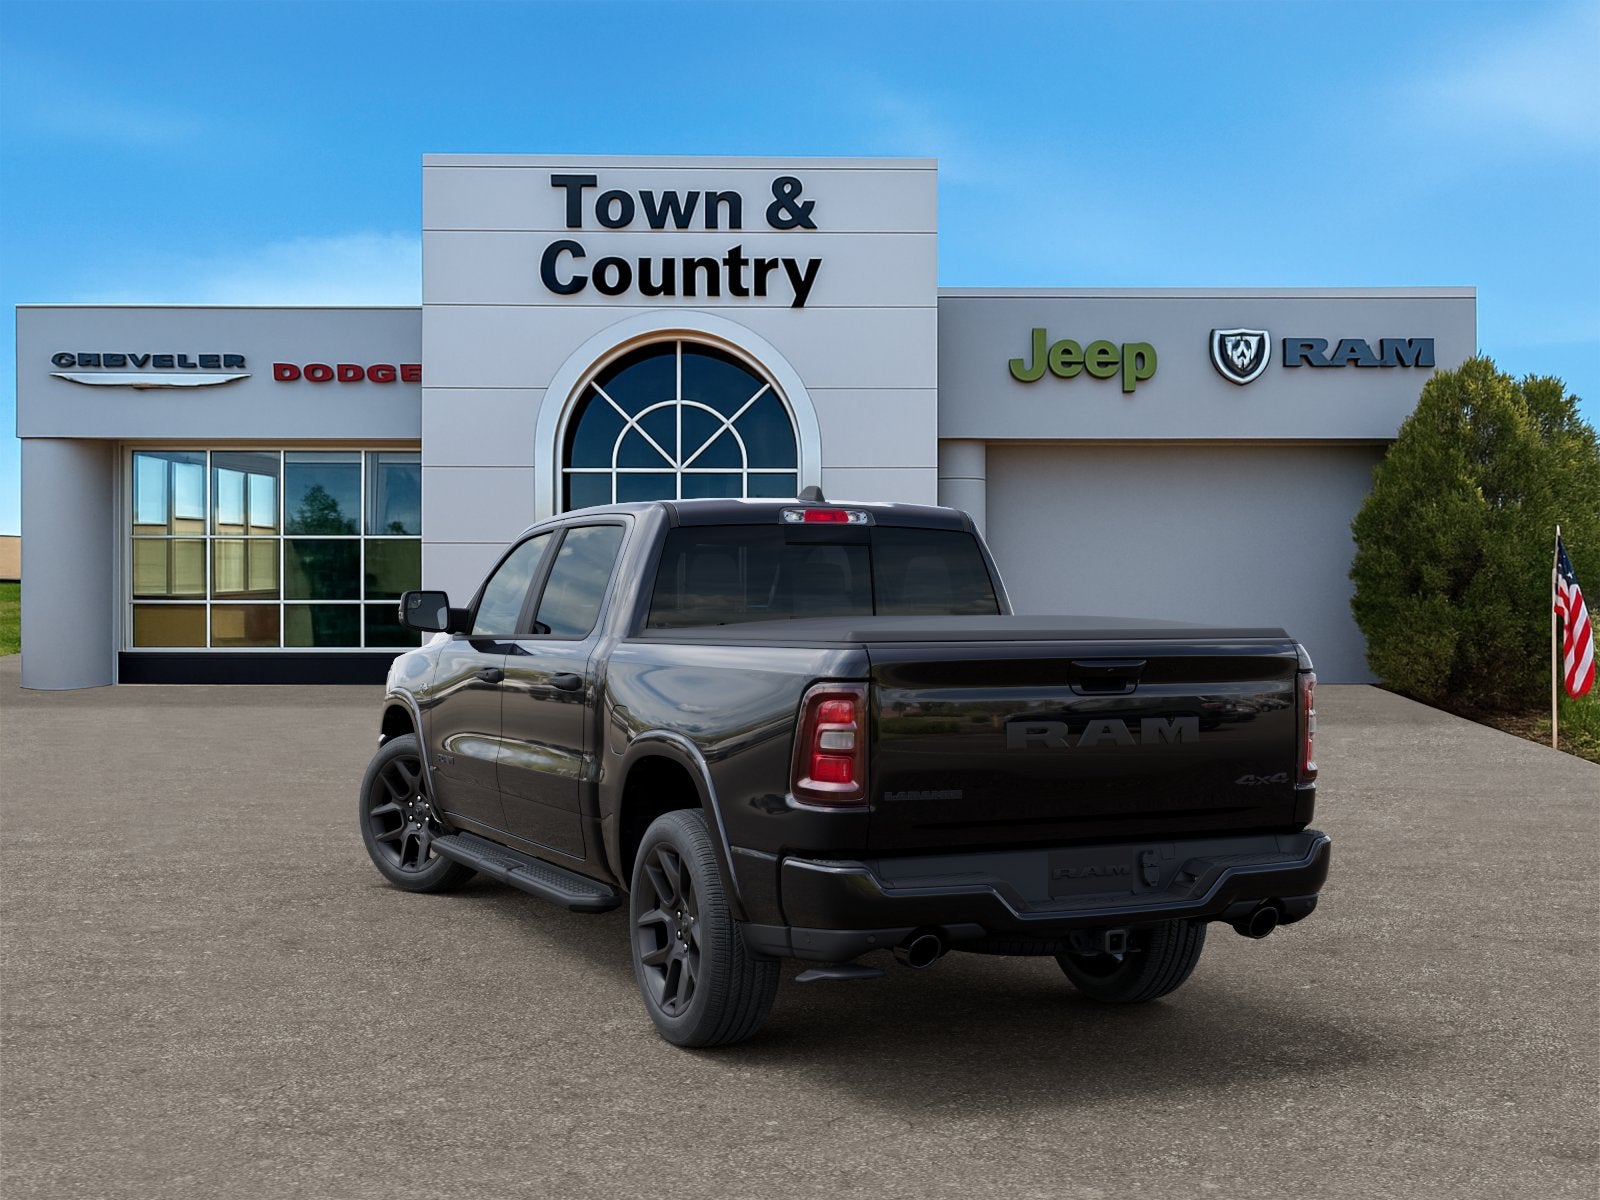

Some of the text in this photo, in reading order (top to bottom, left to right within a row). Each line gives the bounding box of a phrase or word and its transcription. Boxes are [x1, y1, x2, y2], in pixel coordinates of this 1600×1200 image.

[550, 174, 818, 230] Town &
[540, 239, 823, 308] Country
[1009, 327, 1158, 393] Jeep
[1282, 337, 1436, 368] RAM
[273, 362, 422, 382] DODGE
[1006, 716, 1200, 750] RAM
[1234, 772, 1290, 786] 4x4
[1051, 864, 1133, 880] RAM
